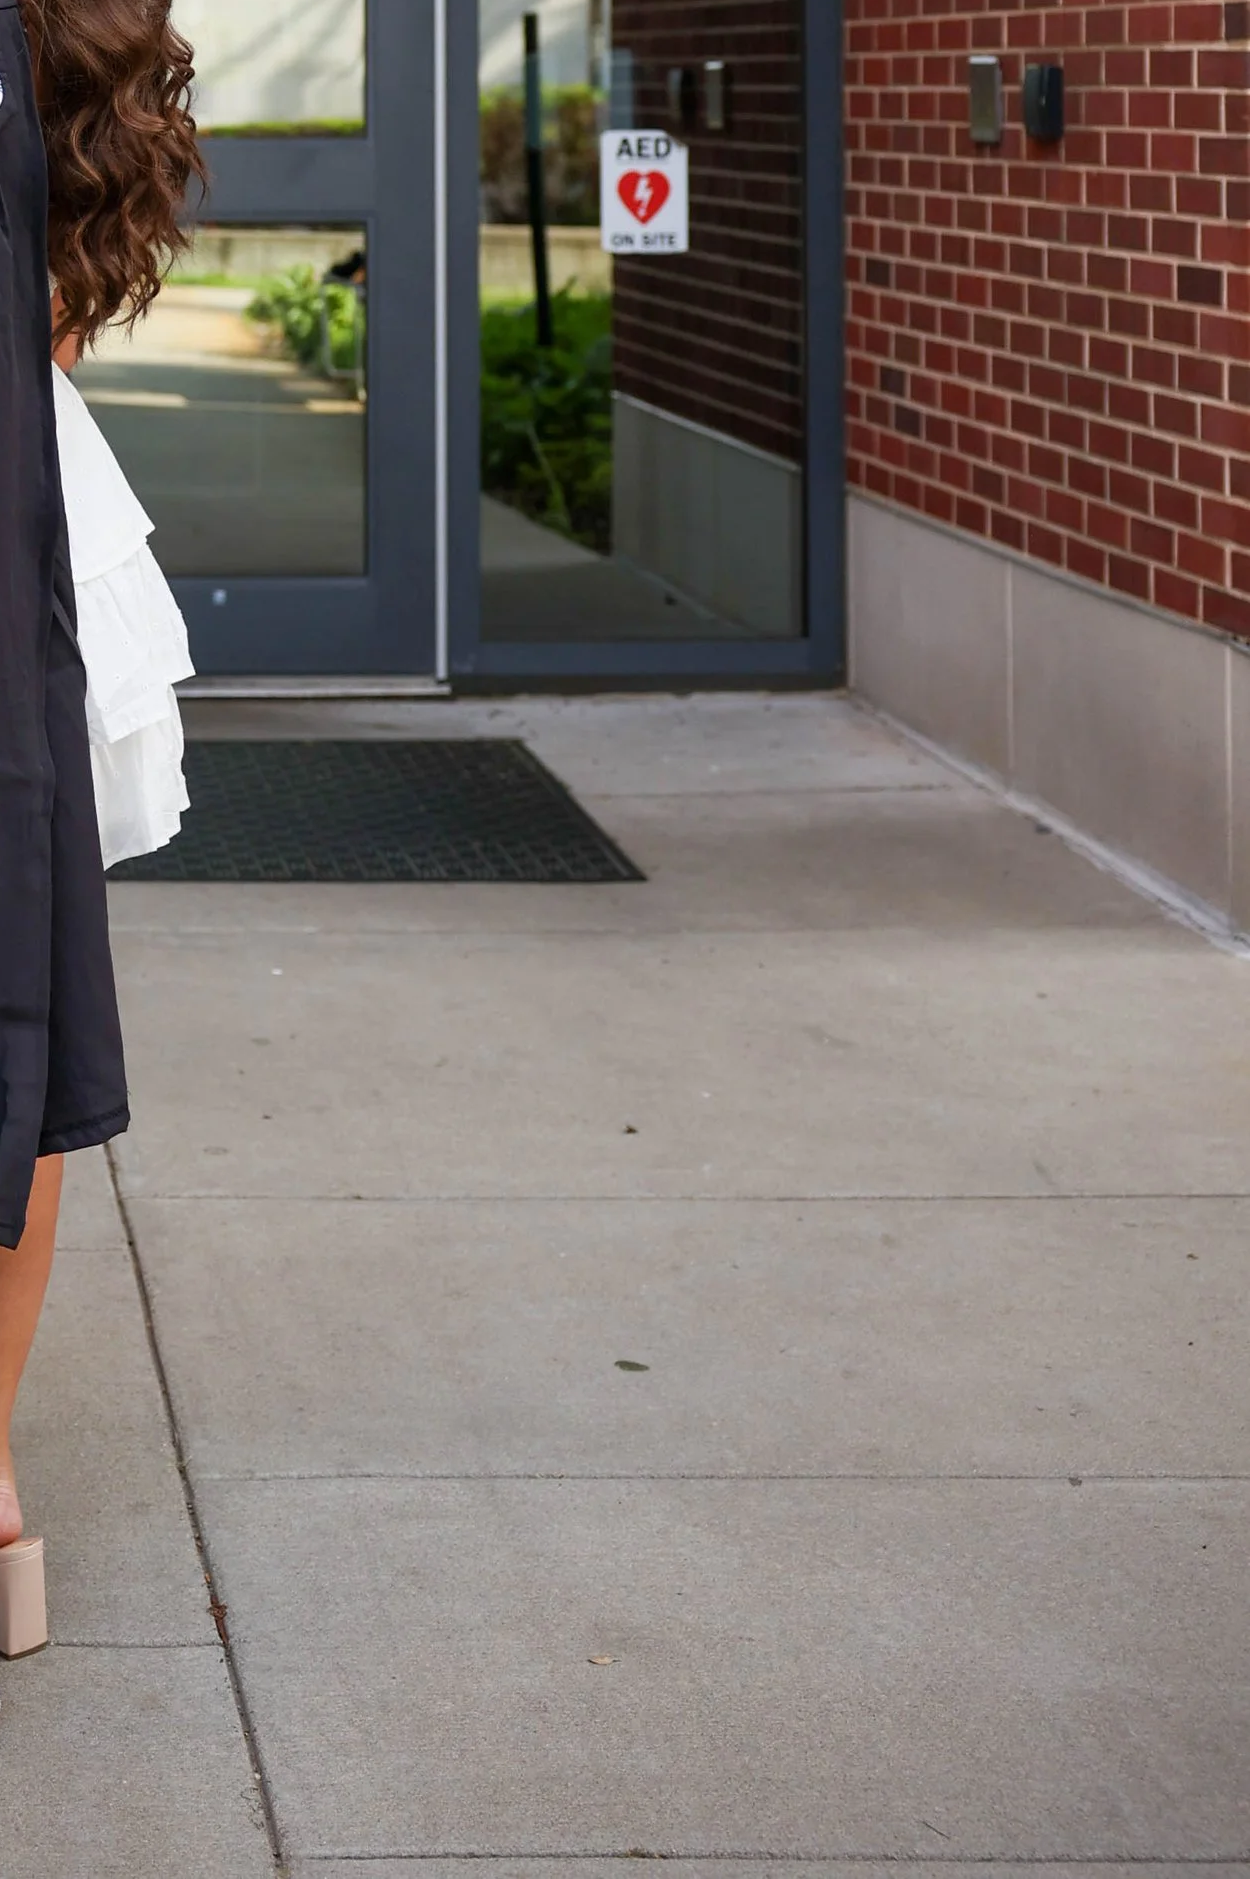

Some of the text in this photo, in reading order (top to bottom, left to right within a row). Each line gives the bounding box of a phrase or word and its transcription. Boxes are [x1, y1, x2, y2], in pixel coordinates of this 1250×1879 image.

[617, 137, 672, 158] AED
[611, 234, 676, 246] ON SITE
